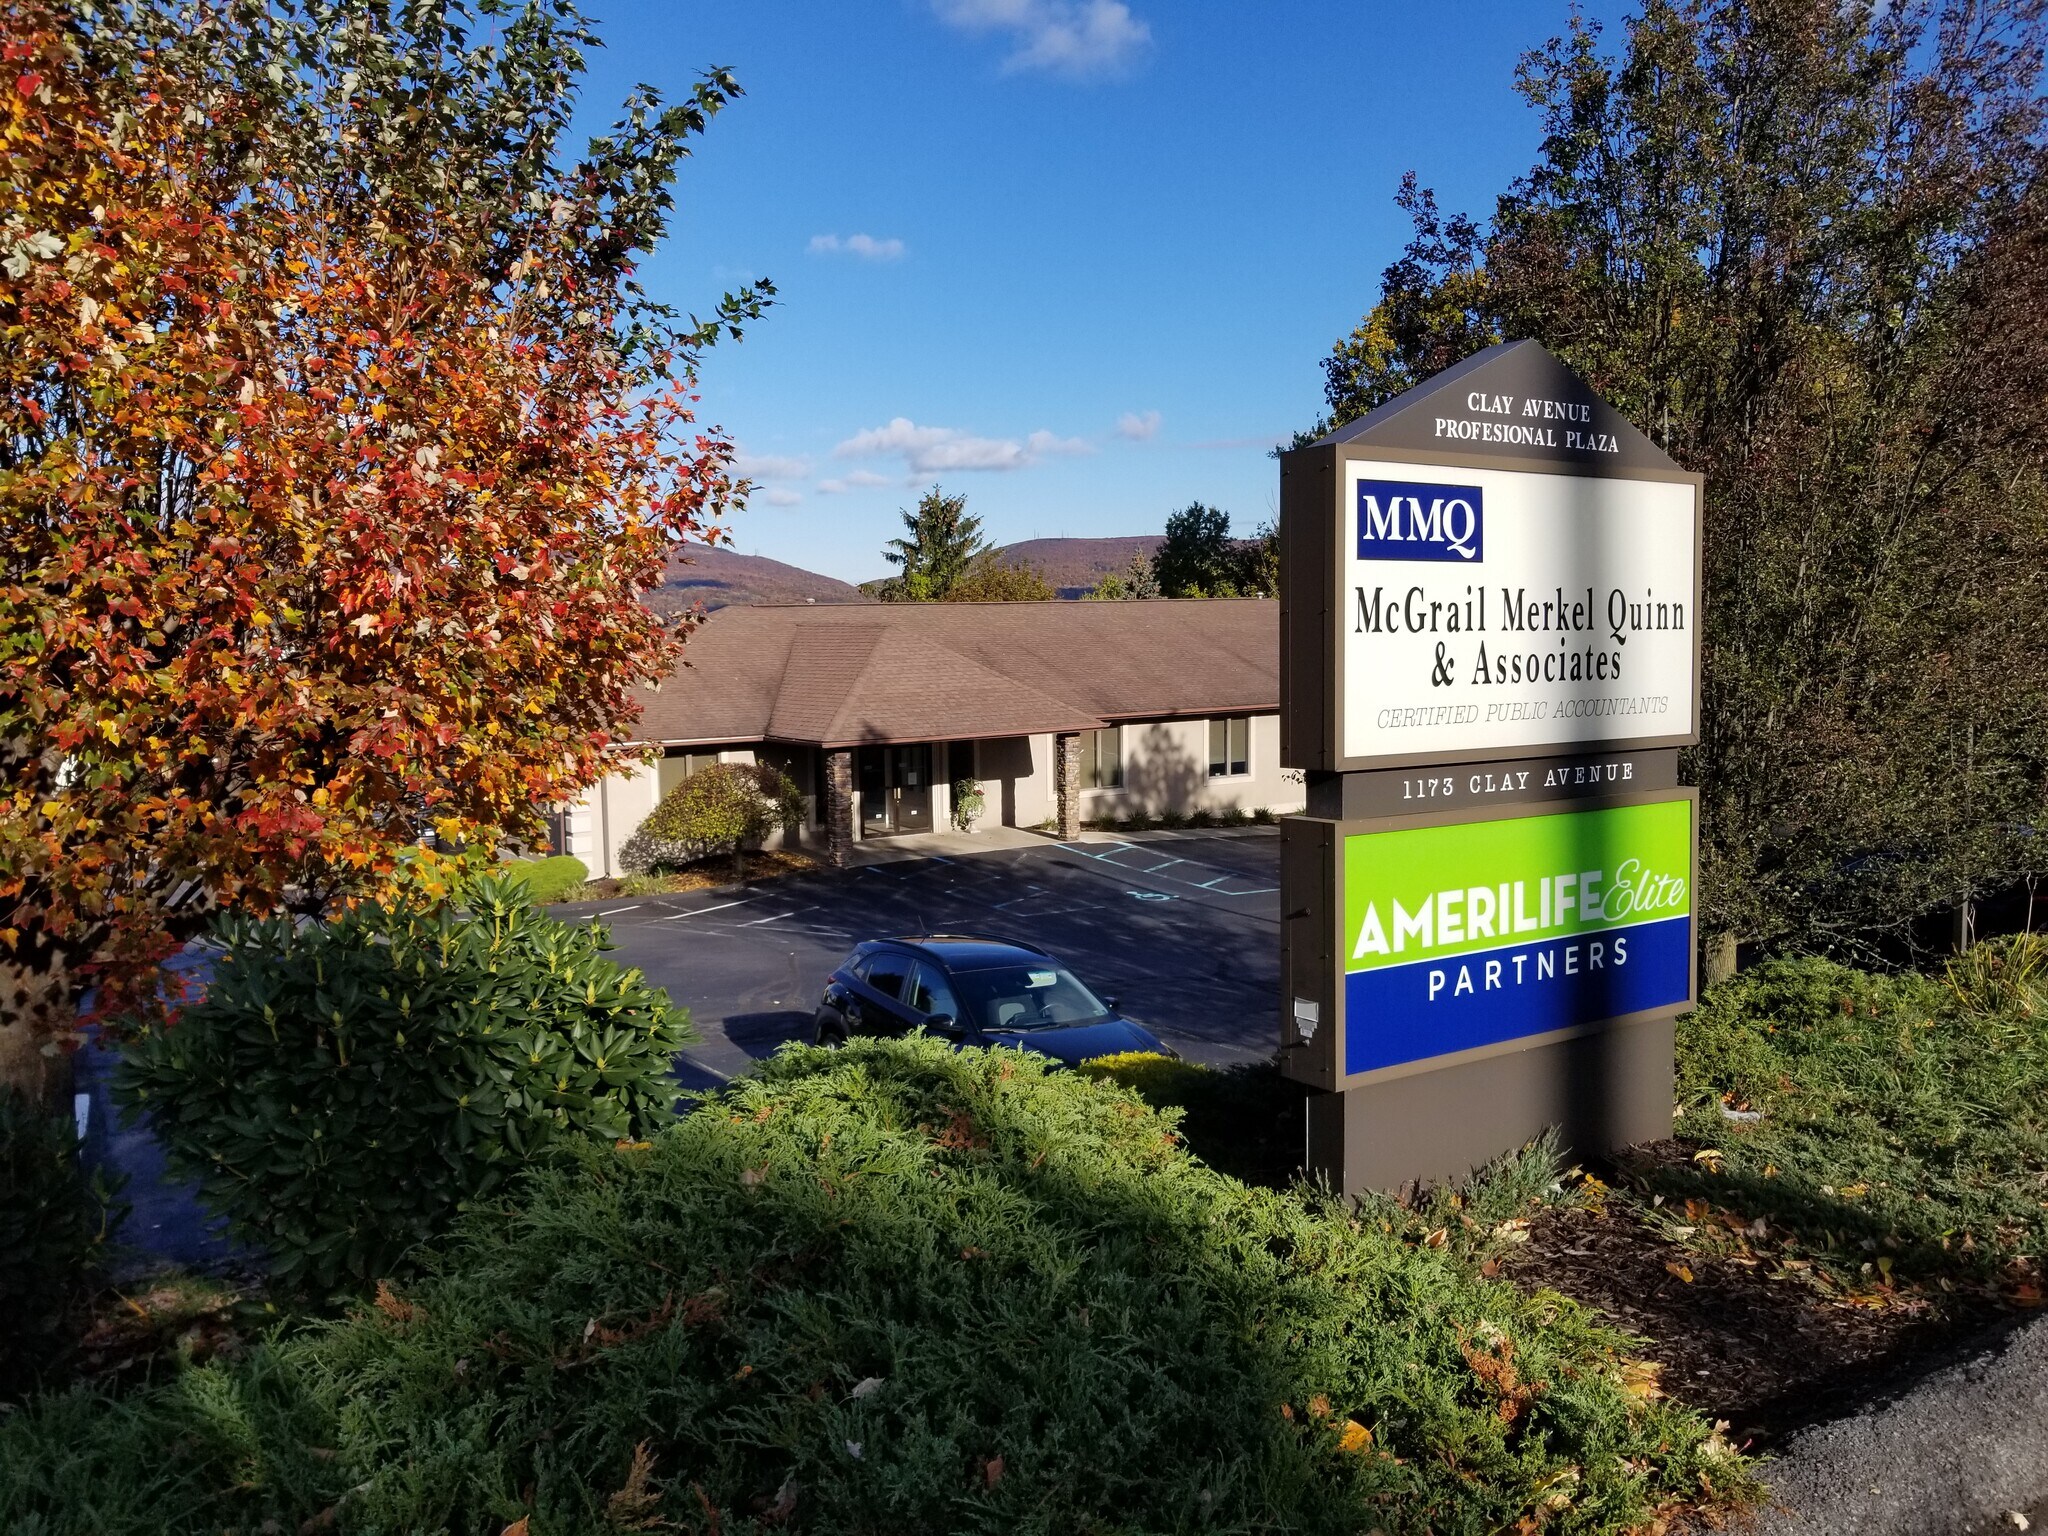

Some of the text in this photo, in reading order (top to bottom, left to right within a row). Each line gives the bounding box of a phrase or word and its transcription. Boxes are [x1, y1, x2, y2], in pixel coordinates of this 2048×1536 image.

[1467, 391, 1591, 424] CLAY AVENUE
[1434, 418, 1620, 454] PROFESIONAL PLAZA
[1362, 494, 1477, 560] MMQ
[1354, 584, 1686, 645] McGrail Merkel Quinn
[1431, 636, 1622, 688] & Associates
[1377, 695, 1669, 730] CERTIFIED PUBLIC ACCOUNTANTS
[1403, 762, 1634, 800] 1173 CLAY AVENUE
[1351, 858, 1686, 960] AMERILIFE Elite
[1428, 937, 1628, 1001] PARTNERS
